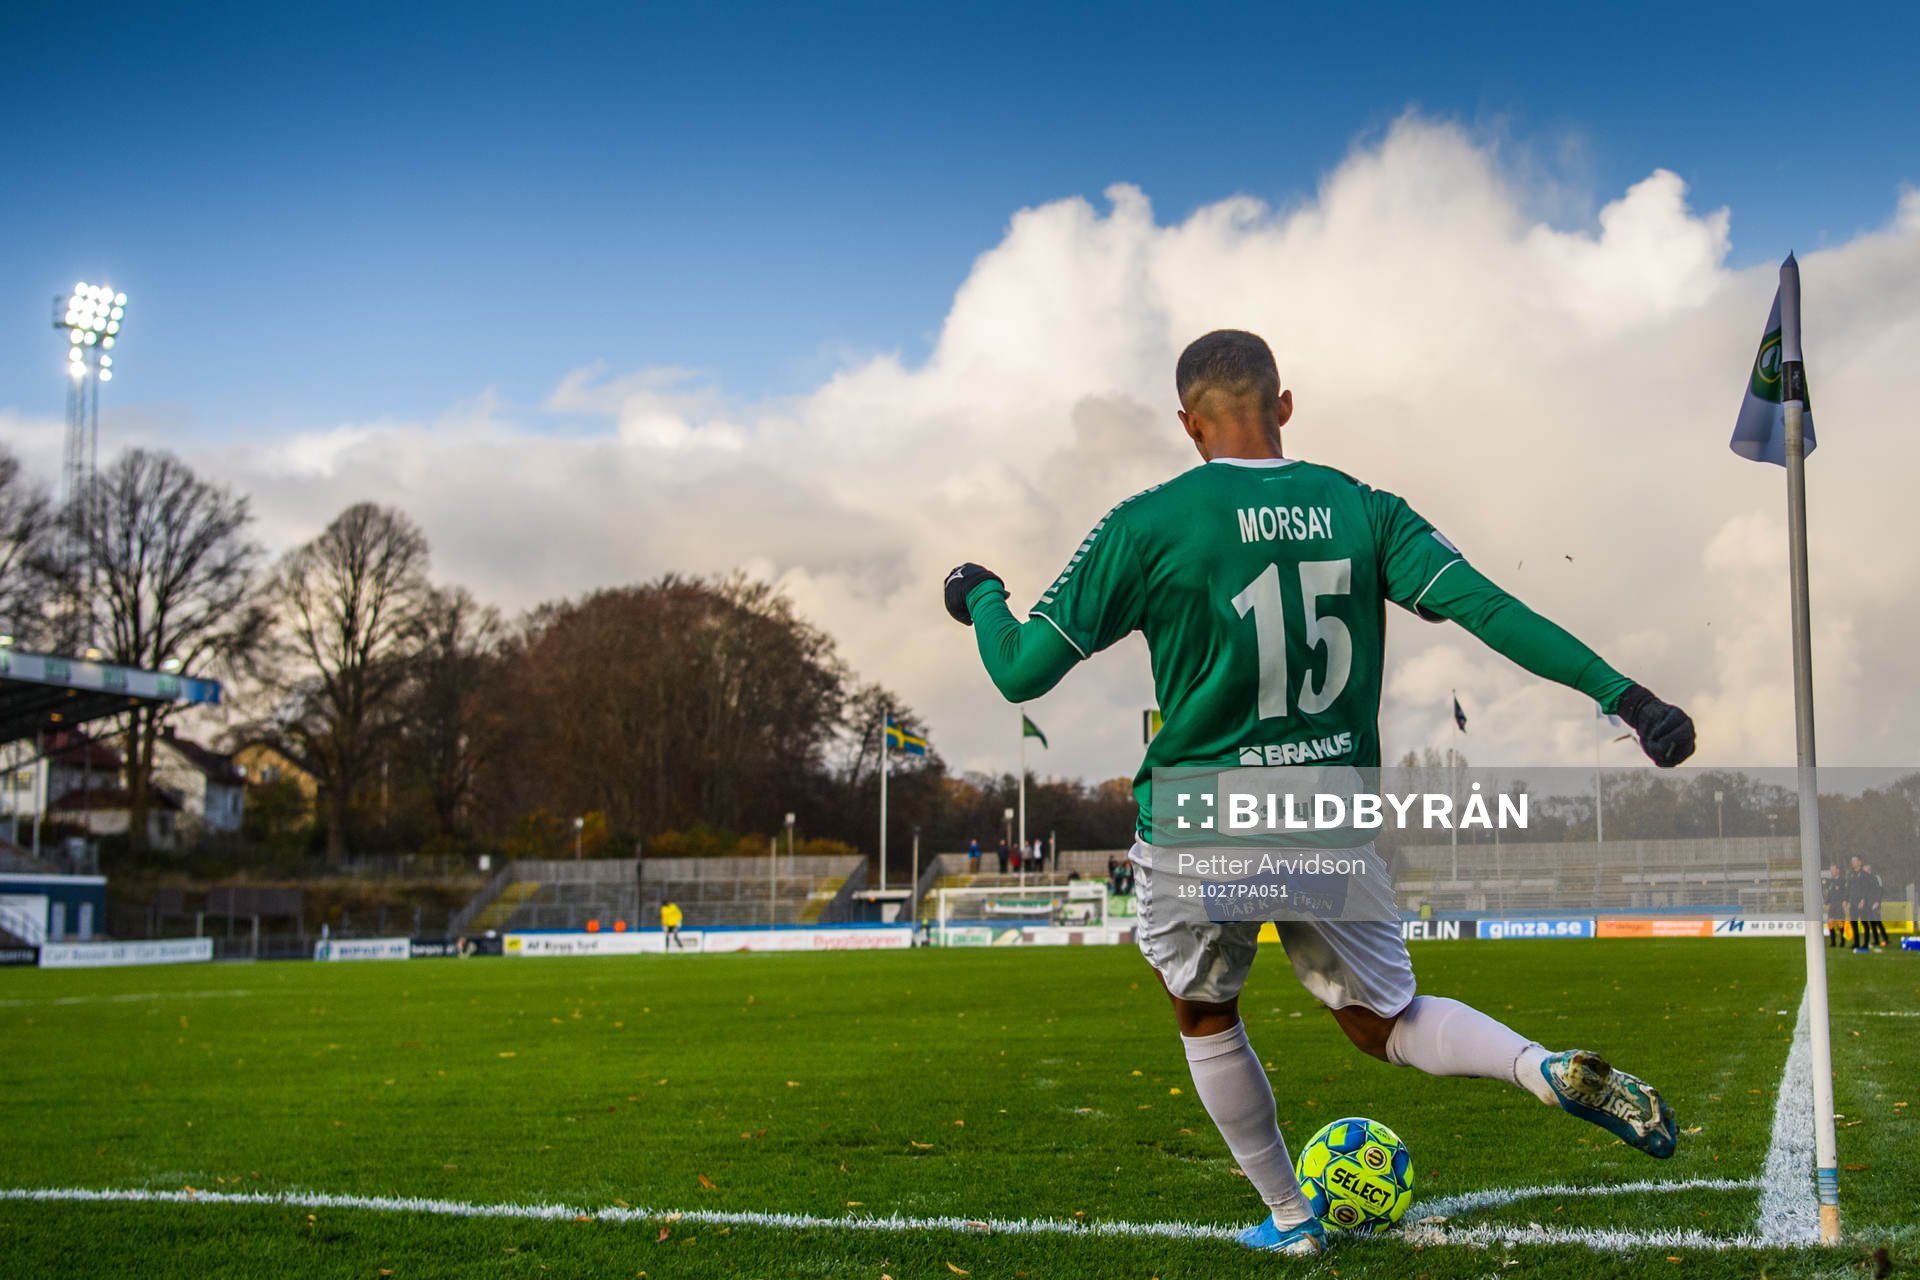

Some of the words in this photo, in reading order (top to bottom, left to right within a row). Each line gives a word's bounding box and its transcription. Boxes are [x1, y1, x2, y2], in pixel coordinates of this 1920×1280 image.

[1237, 506, 1333, 543] MORSAY
[1231, 558, 1352, 720] 15
[1488, 920, 1582, 939] ginza.se
[1751, 922, 1804, 930] MIDROC
[1331, 1167, 1391, 1207] SELECT
